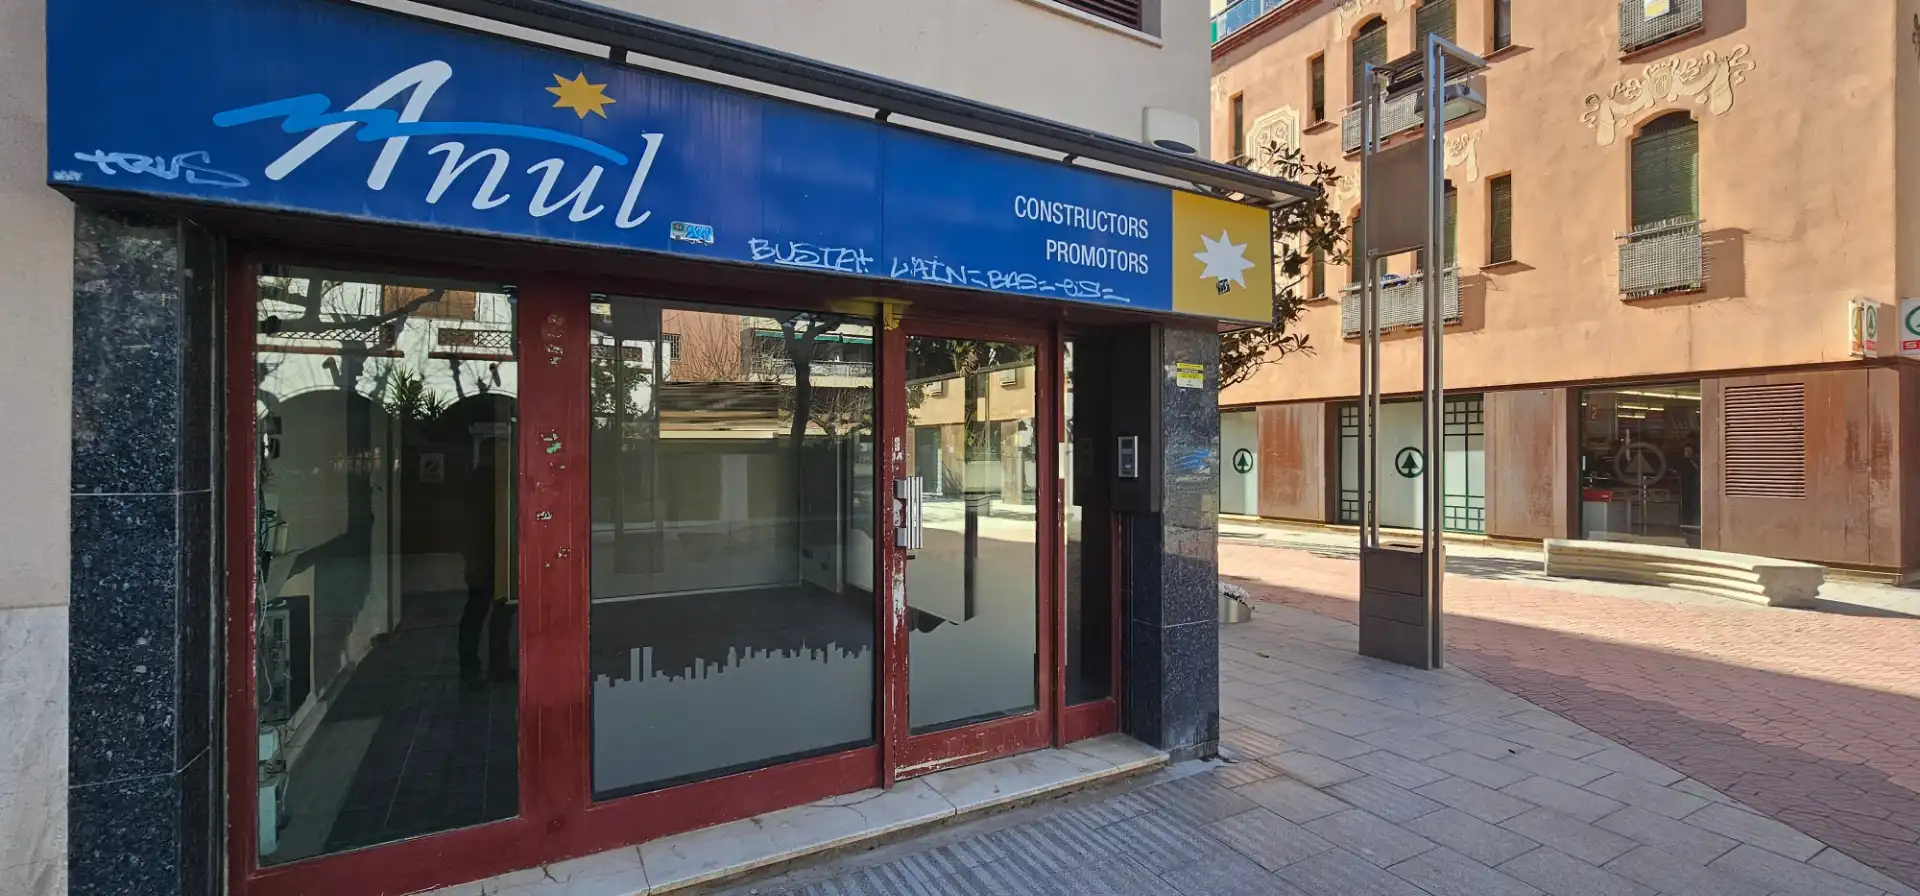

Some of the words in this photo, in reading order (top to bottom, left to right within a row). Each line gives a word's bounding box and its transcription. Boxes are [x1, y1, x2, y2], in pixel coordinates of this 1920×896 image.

[265, 60, 664, 229] Anul
[1014, 195, 1149, 239] CONSTRUCTORS
[1046, 239, 1149, 275] PROMOTORS
